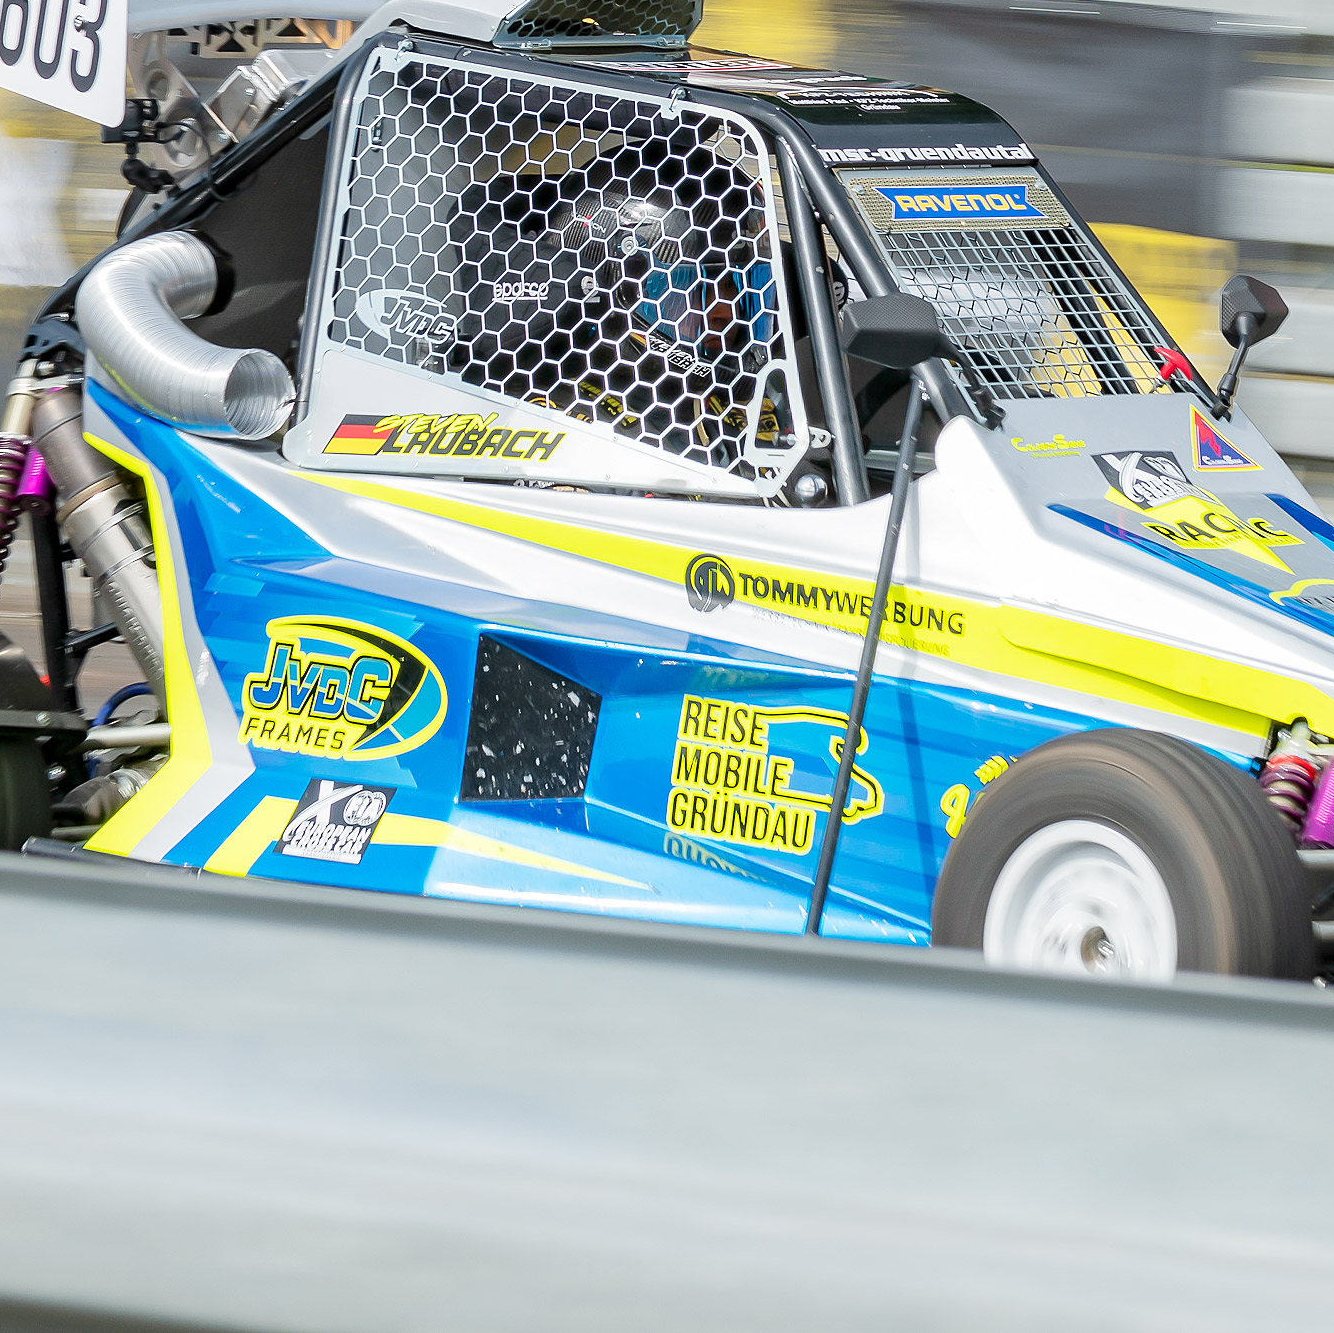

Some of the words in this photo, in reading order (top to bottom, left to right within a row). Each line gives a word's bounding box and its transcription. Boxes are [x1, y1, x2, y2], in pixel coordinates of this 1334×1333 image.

[372, 412, 500, 434] STEVEN
[381, 424, 567, 462] LAUBACH
[249, 641, 393, 726] JVDC
[245, 717, 346, 750] FRAMES
[683, 699, 765, 747] REISE
[676, 746, 789, 796] MOBILE
[671, 791, 810, 849] GRÜNDAU
